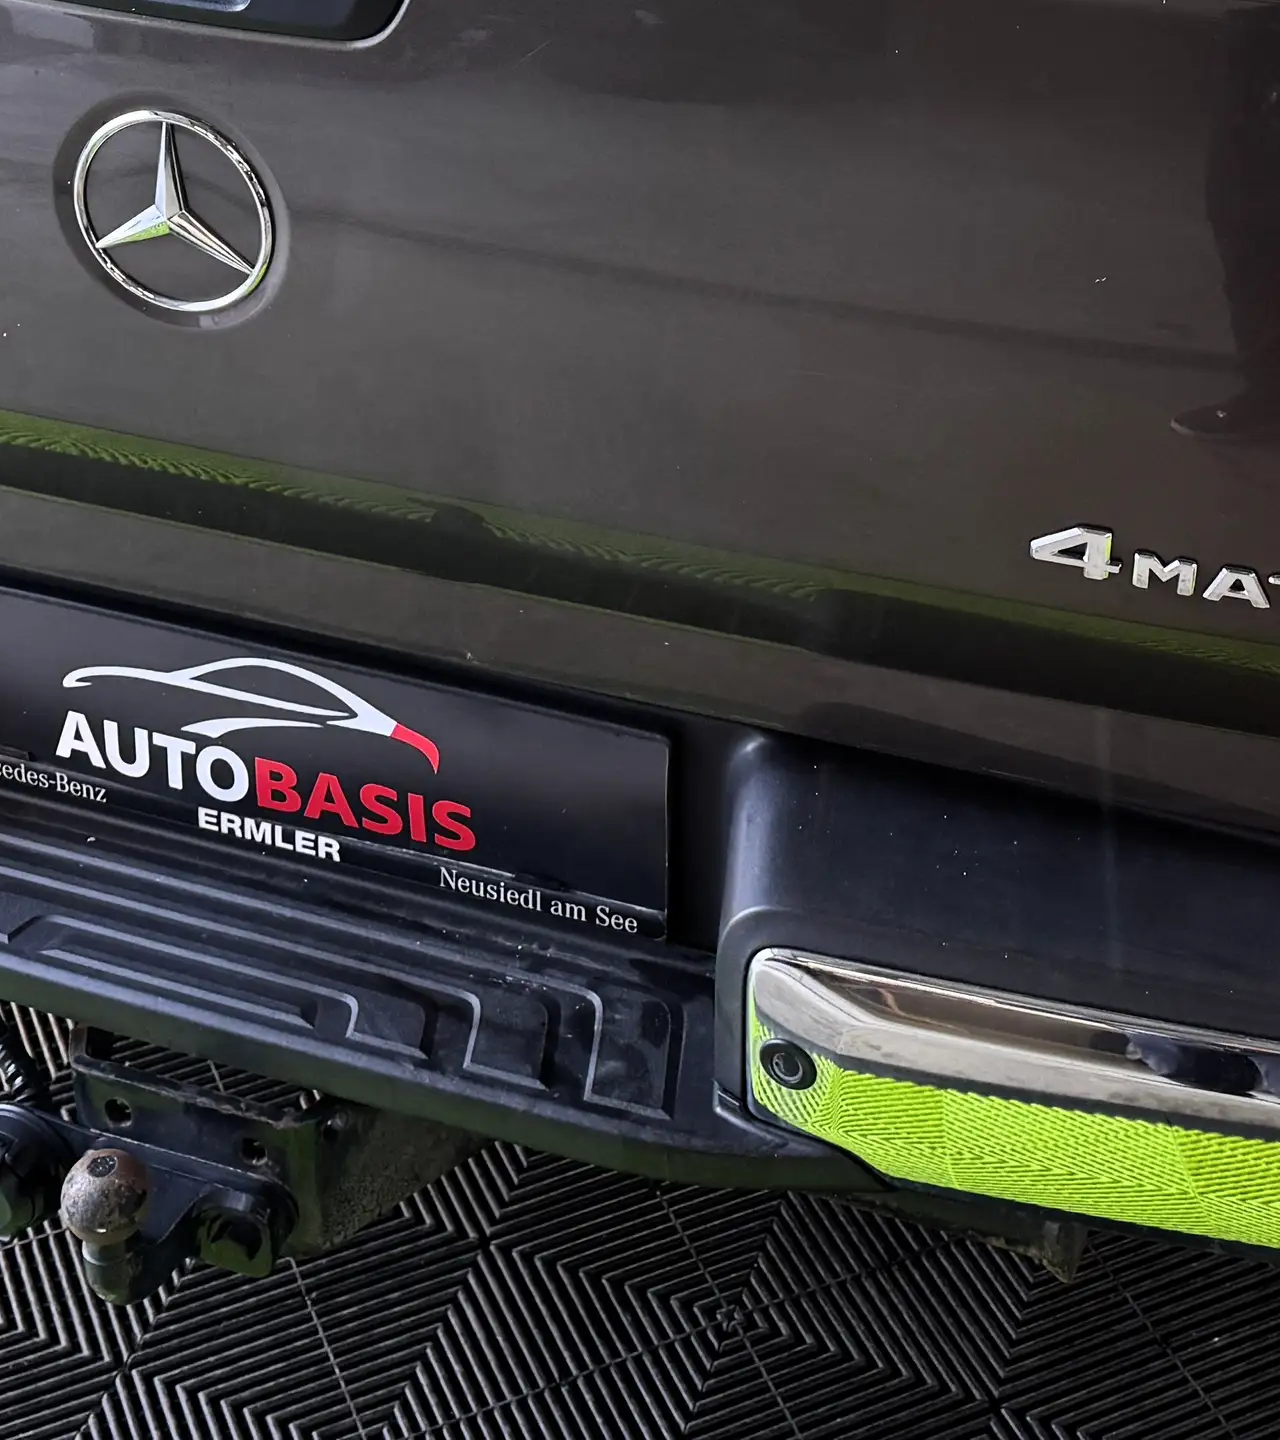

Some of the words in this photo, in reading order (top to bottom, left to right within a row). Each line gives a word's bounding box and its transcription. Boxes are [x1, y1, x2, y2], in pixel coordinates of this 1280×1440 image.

[55, 710, 477, 852] AUTOBASIS
[197, 806, 341, 862] ERMLER
[439, 866, 542, 912] Neusiedl
[550, 899, 587, 922] am
[595, 905, 638, 934] See
